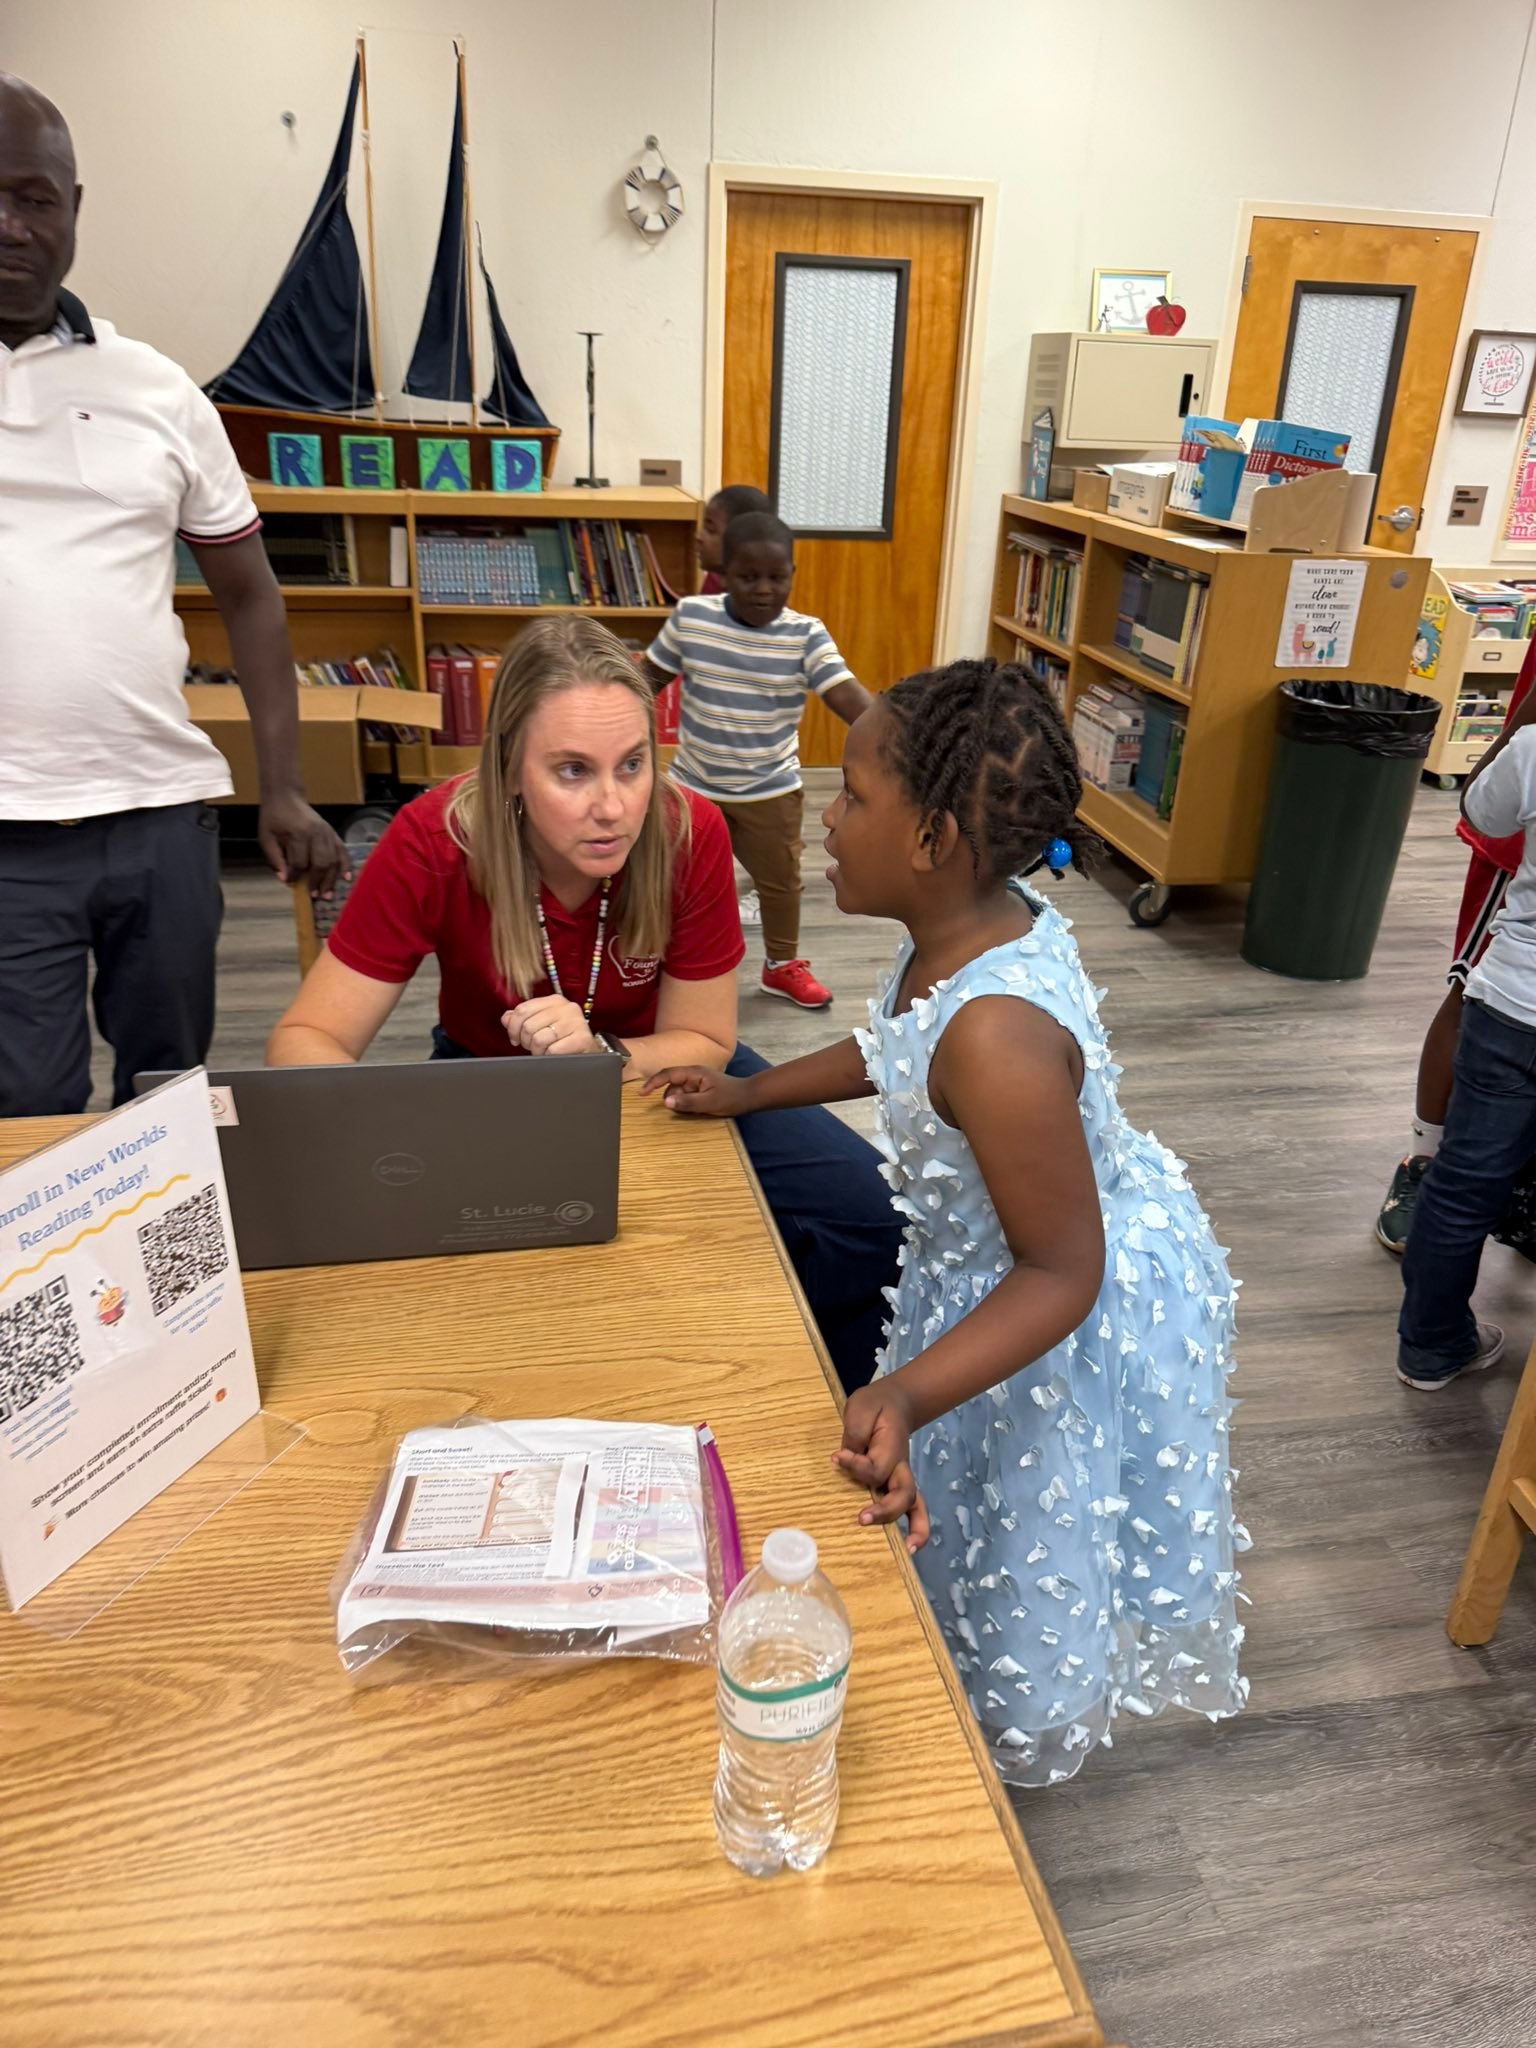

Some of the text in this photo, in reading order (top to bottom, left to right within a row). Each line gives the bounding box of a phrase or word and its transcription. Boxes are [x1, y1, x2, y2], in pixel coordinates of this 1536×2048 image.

[276, 437, 537, 491] READ
[1273, 455, 1325, 474] Diction
[1293, 438, 1327, 460] First
[0, 1125, 168, 1229] nroll in New Worlds
[17, 1164, 150, 1252] Reading Today!
[460, 1203, 547, 1220] St. Lucie
[31, 1482, 60, 1509] Show
[60, 1462, 85, 1488] your
[86, 1424, 136, 1468] completed
[210, 1347, 238, 1375] survey
[50, 1476, 86, 1508] screen
[86, 1460, 106, 1482] and
[106, 1445, 128, 1465] earn
[128, 1435, 141, 1449] an
[141, 1416, 165, 1439] extra
[164, 1400, 188, 1421] raffle
[432, 1446, 448, 1454] and
[88, 1470, 126, 1502] chances
[126, 1461, 137, 1473] to
[136, 1450, 153, 1465] win
[152, 1422, 186, 1452] amazing
